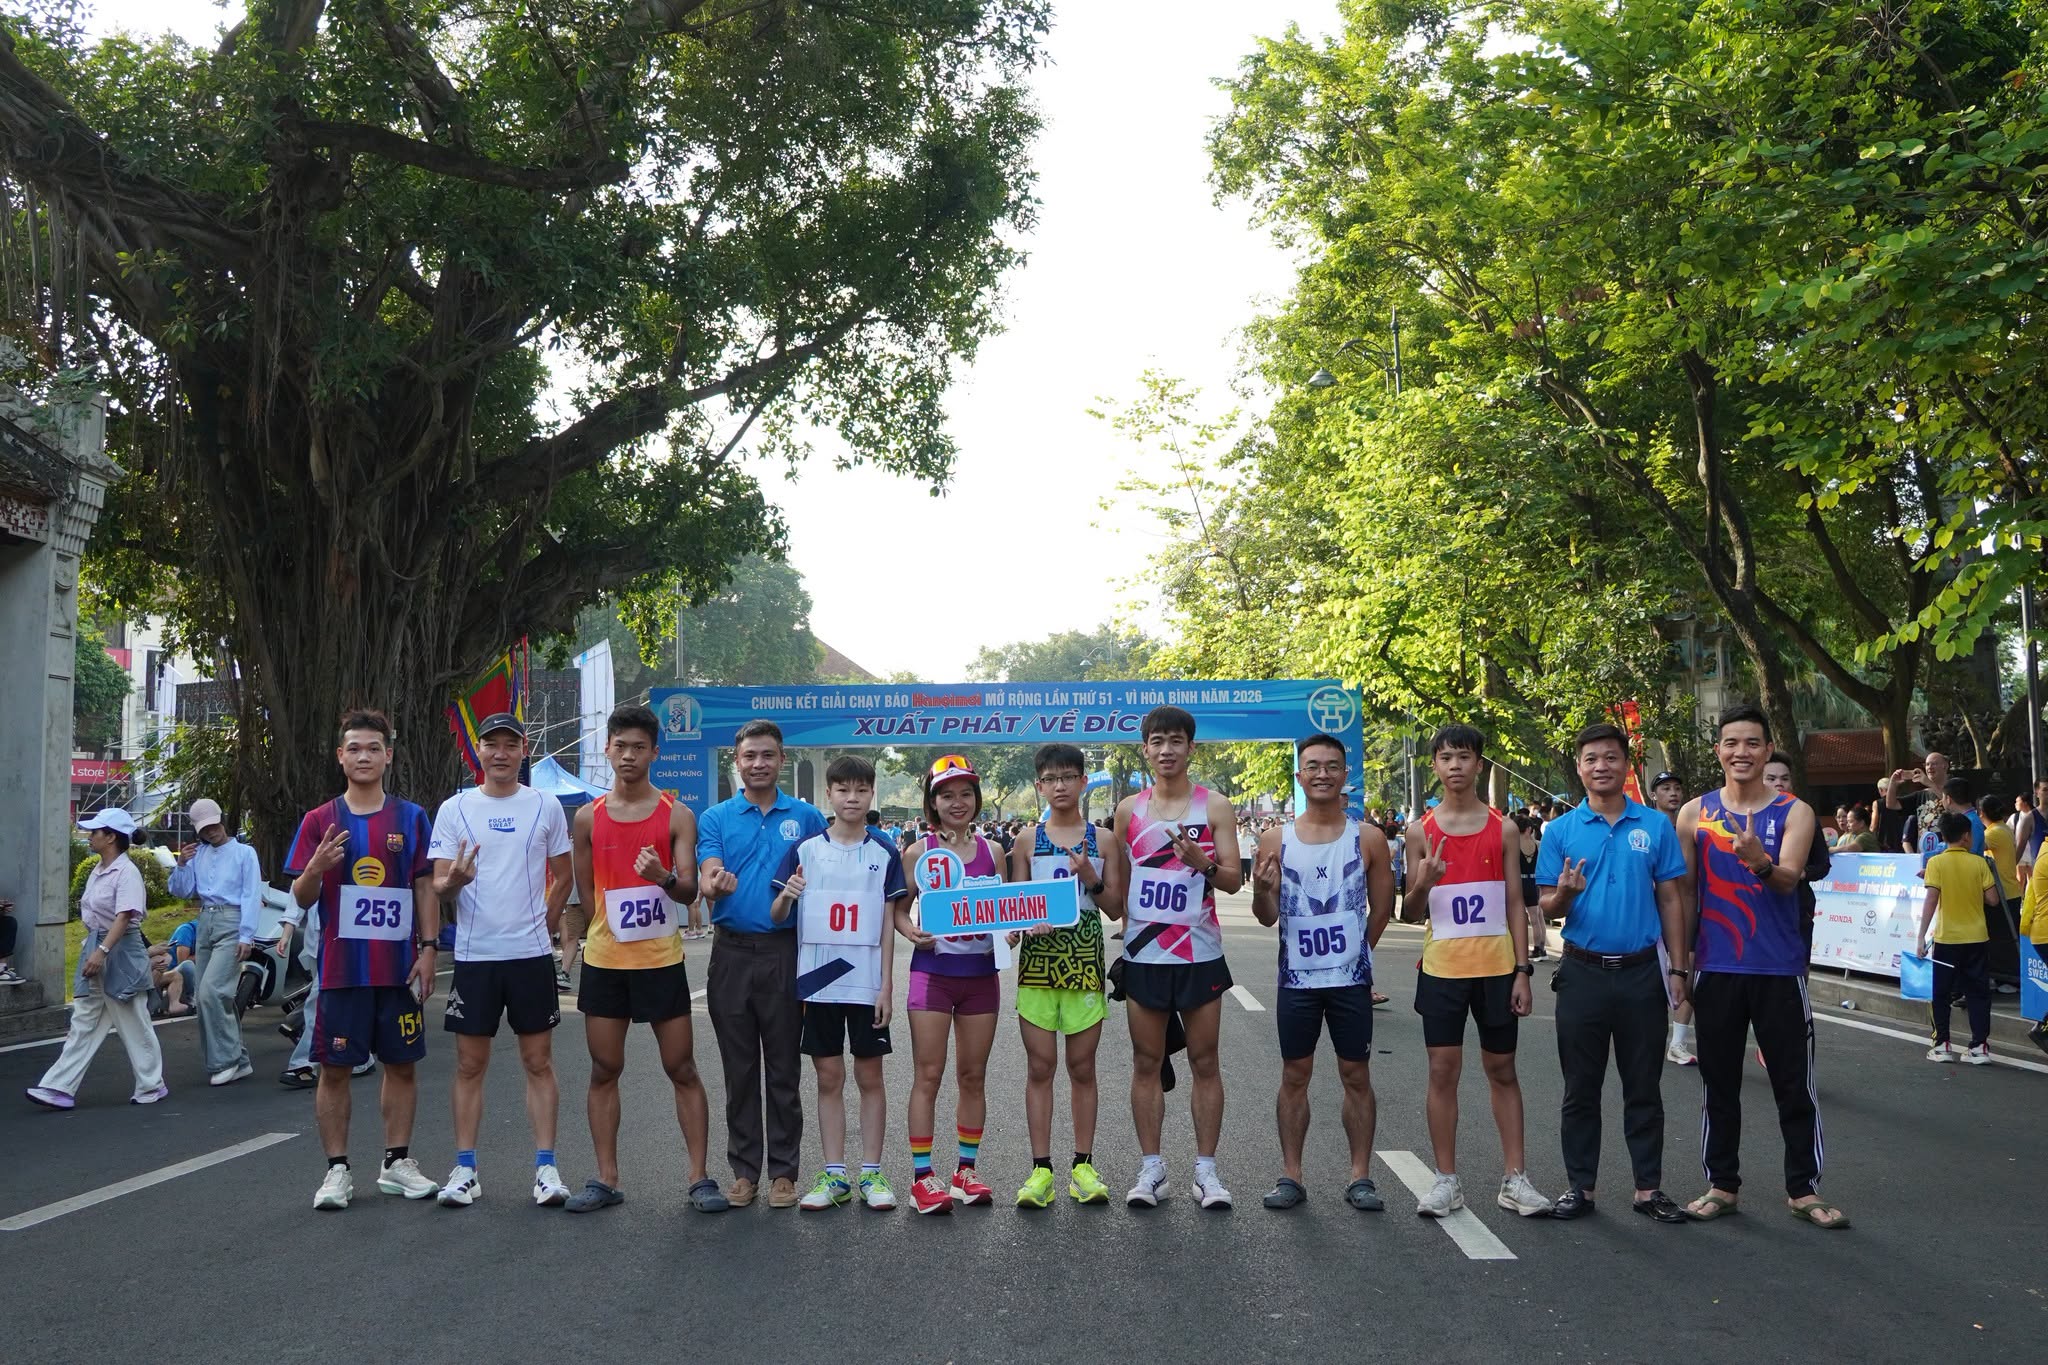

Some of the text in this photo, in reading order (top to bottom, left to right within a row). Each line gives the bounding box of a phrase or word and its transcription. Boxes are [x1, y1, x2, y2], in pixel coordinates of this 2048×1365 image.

[751, 696, 793, 710] CHUNG
[796, 692, 818, 709] KẾT
[821, 691, 846, 709] GIẢI
[849, 694, 881, 711] CHẠY
[884, 691, 909, 708] BÁO
[985, 689, 1005, 706] MỞ
[1008, 689, 1042, 709] RỘNG
[1045, 688, 1068, 706] LẦN
[1072, 689, 1096, 706] THỨ
[1099, 692, 1112, 705] 51
[1125, 688, 1138, 705] VÌ
[1142, 689, 1166, 705] HÒA
[1168, 688, 1198, 704] BÌNH
[1201, 687, 1229, 703] NĂM
[1232, 690, 1262, 703] 2026
[853, 709, 936, 736] XUẤT
[1083, 709, 1148, 734] ĐÍC
[77, 766, 105, 777] store
[660, 753, 697, 763] NHIỆT LIỆT
[656, 768, 703, 779] CHÀO MỪNG
[681, 792, 699, 801] NĂM
[927, 856, 951, 890] 51
[951, 890, 1048, 926] XÃ AN KHÁNH
[1139, 879, 1188, 912] 506
[1452, 894, 1486, 925] 02
[354, 898, 402, 928] 253
[619, 897, 667, 929] 254
[829, 903, 859, 932] 01
[1829, 914, 1853, 924] HONDA
[1298, 925, 1347, 957] 505
[1860, 927, 1877, 935] TOYOTA
